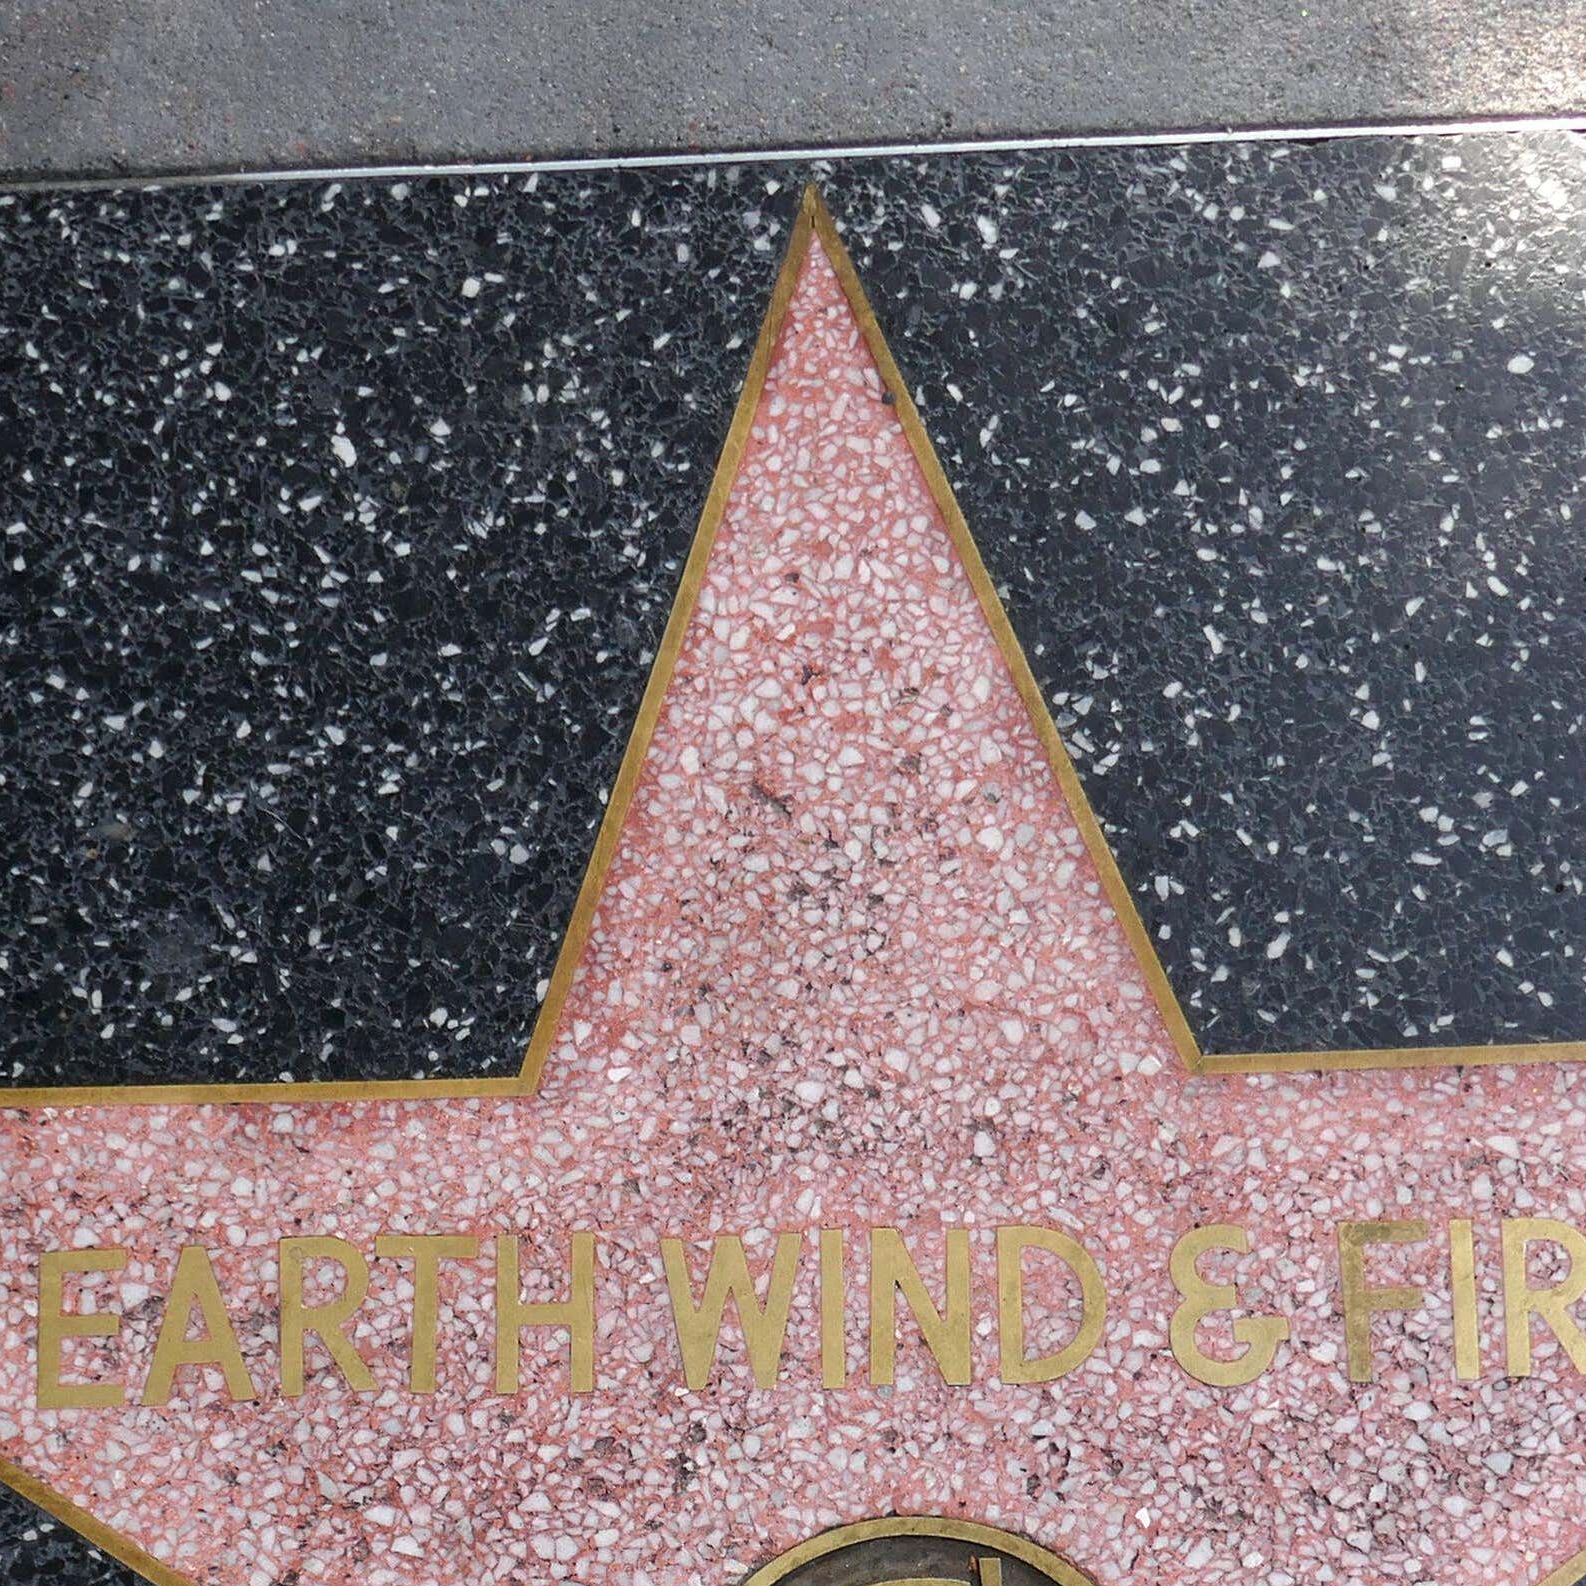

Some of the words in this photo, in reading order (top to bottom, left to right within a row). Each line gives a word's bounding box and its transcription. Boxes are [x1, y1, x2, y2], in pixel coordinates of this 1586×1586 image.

[37, 1231, 595, 1408] EARTH
[661, 1224, 1107, 1390] WIND
[1168, 1223, 1290, 1387] &
